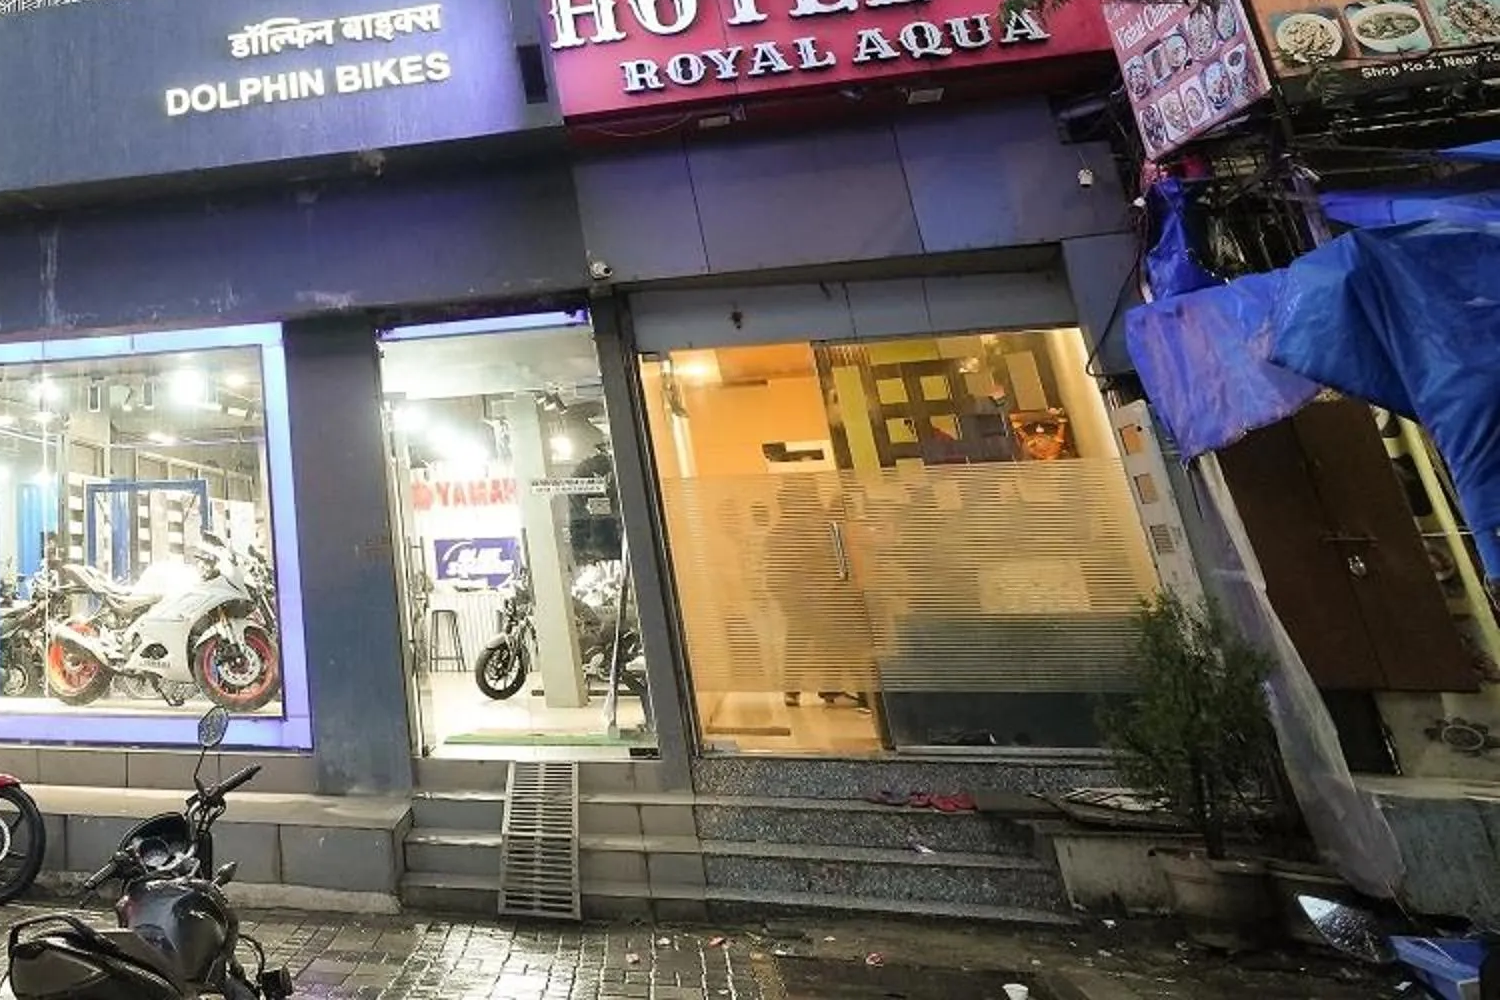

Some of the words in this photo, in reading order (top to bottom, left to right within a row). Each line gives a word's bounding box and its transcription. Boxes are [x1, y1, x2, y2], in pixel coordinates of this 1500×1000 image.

[339, 3, 443, 41] बाइक्स
[620, 36, 837, 93] ROYAL
[853, 8, 1050, 64] AQUA
[1361, 65, 1400, 79] Shop
[1443, 55, 1479, 68] Near
[165, 67, 326, 117] DOLPHIN
[335, 52, 452, 94] BIKES
